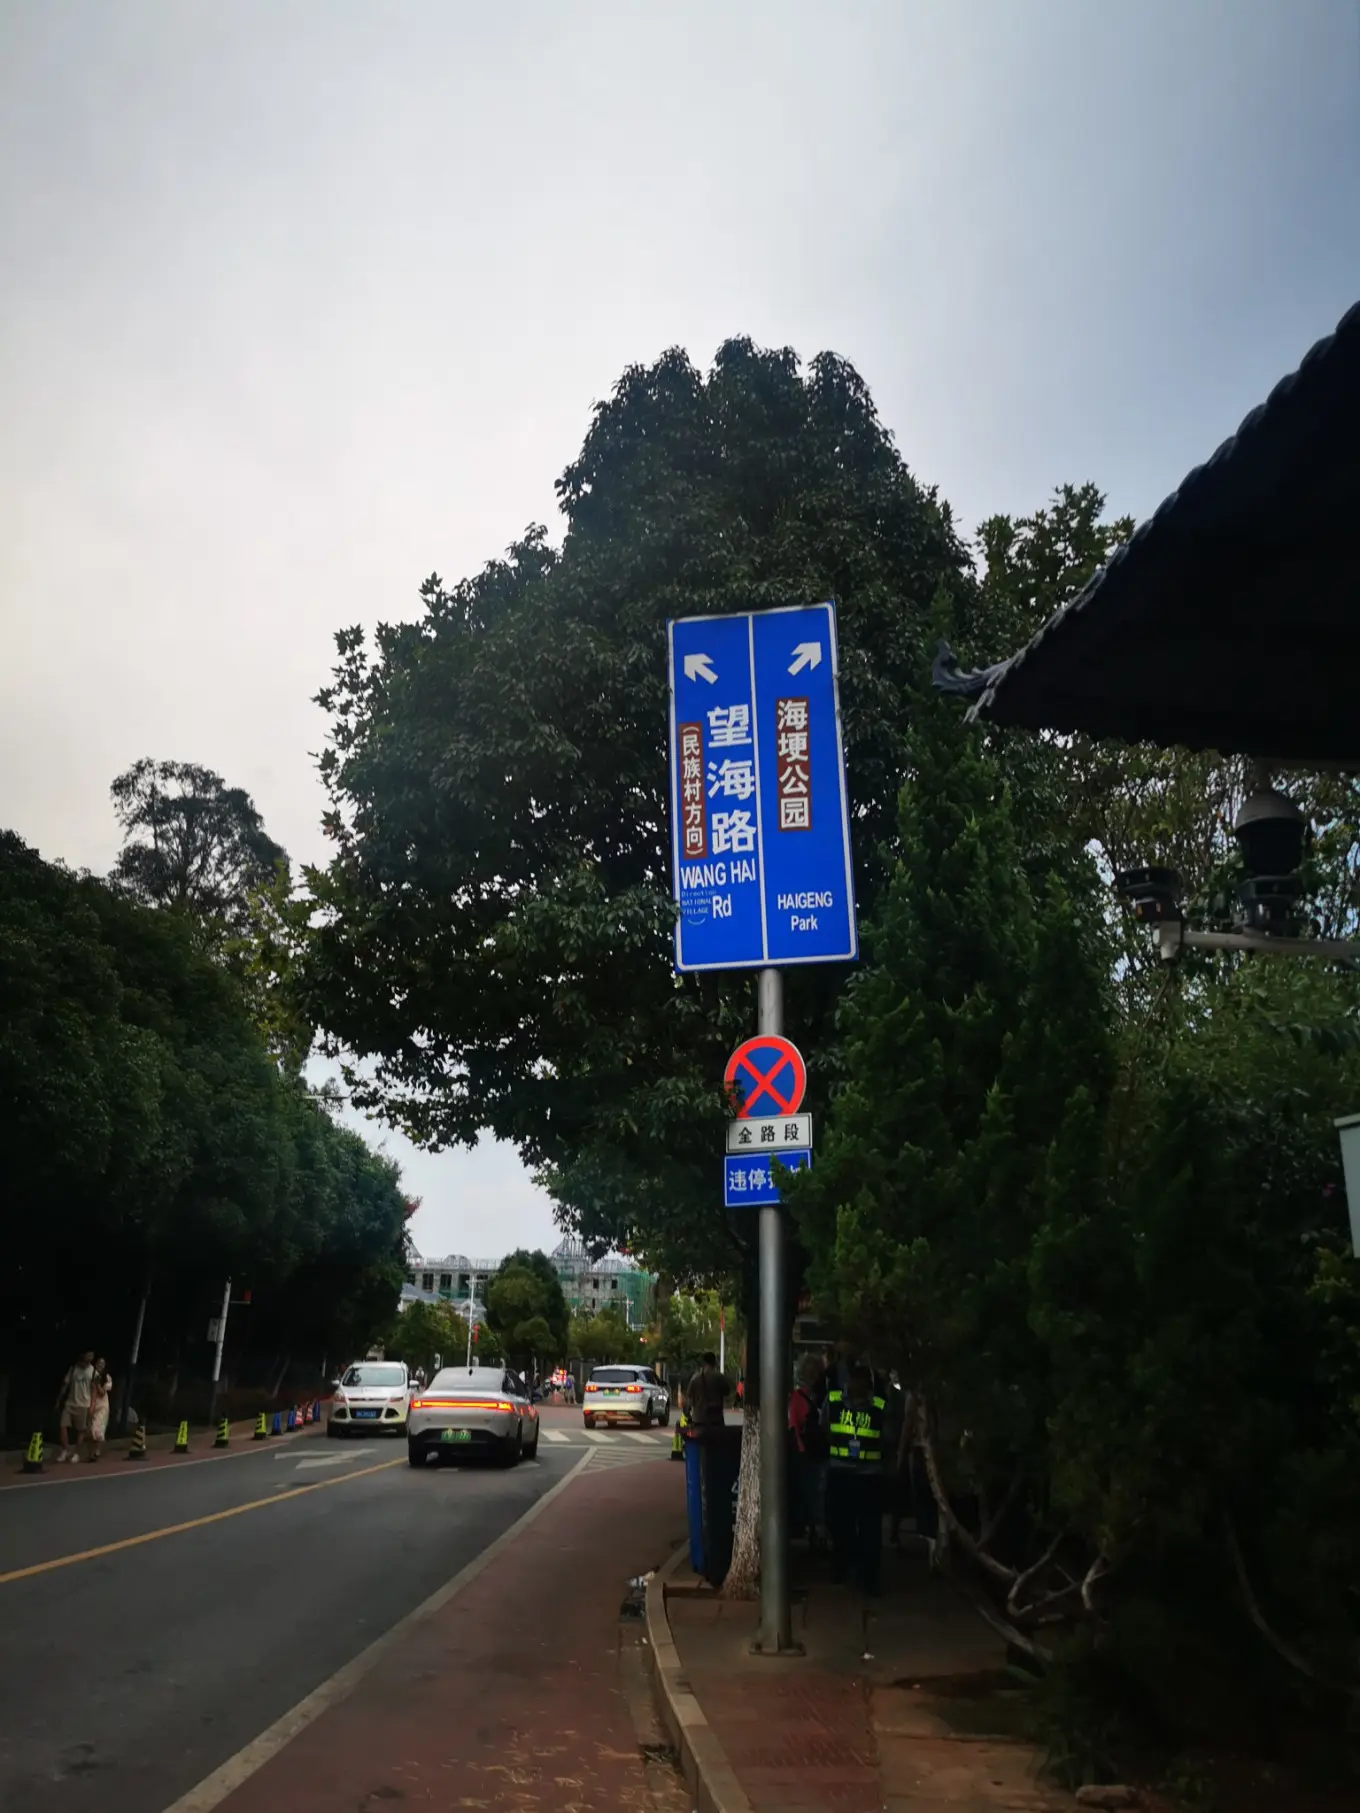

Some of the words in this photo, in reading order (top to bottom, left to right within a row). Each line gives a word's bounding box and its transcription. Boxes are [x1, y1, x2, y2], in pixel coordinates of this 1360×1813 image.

[777, 699, 810, 829] 海埂公园
[706, 703, 756, 855] 望海路
[680, 861, 727, 890] WANG
[730, 858, 756, 884] HAI
[712, 893, 732, 919] Rd
[777, 891, 833, 910] HAIGENG
[790, 914, 818, 932] Park
[738, 1123, 800, 1145] 全路段
